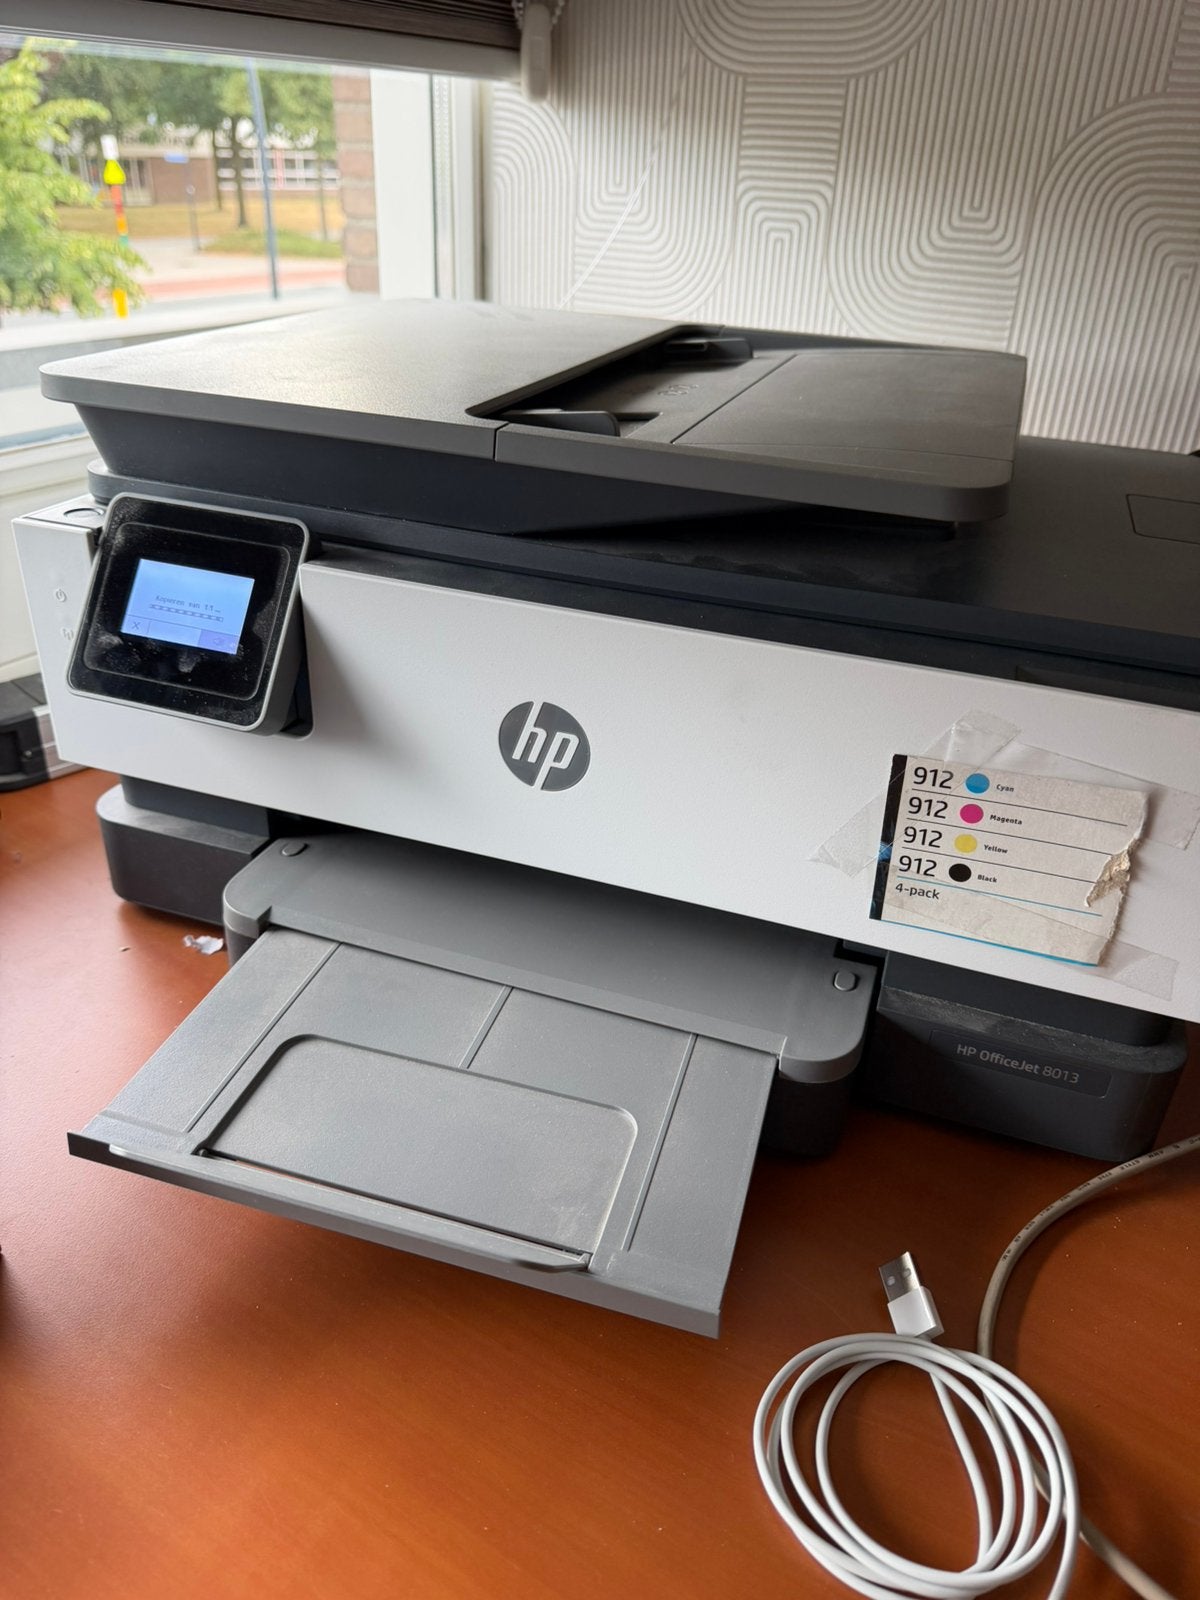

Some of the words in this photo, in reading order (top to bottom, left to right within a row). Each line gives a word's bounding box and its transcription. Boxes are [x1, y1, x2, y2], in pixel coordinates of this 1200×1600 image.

[510, 700, 580, 790] hp
[913, 766, 954, 789] 912
[996, 783, 1015, 793] Cyan
[908, 796, 948, 819] 912
[989, 814, 1023, 825] Magenta
[903, 826, 943, 848] 912
[983, 844, 1008, 854] Yellow
[898, 855, 937, 877] 912
[977, 874, 997, 883] Black
[895, 882, 940, 899] 4-pack
[956, 1043, 977, 1057] HP
[979, 1049, 1040, 1075] OfficeJet
[1042, 1065, 1080, 1084] 8013
